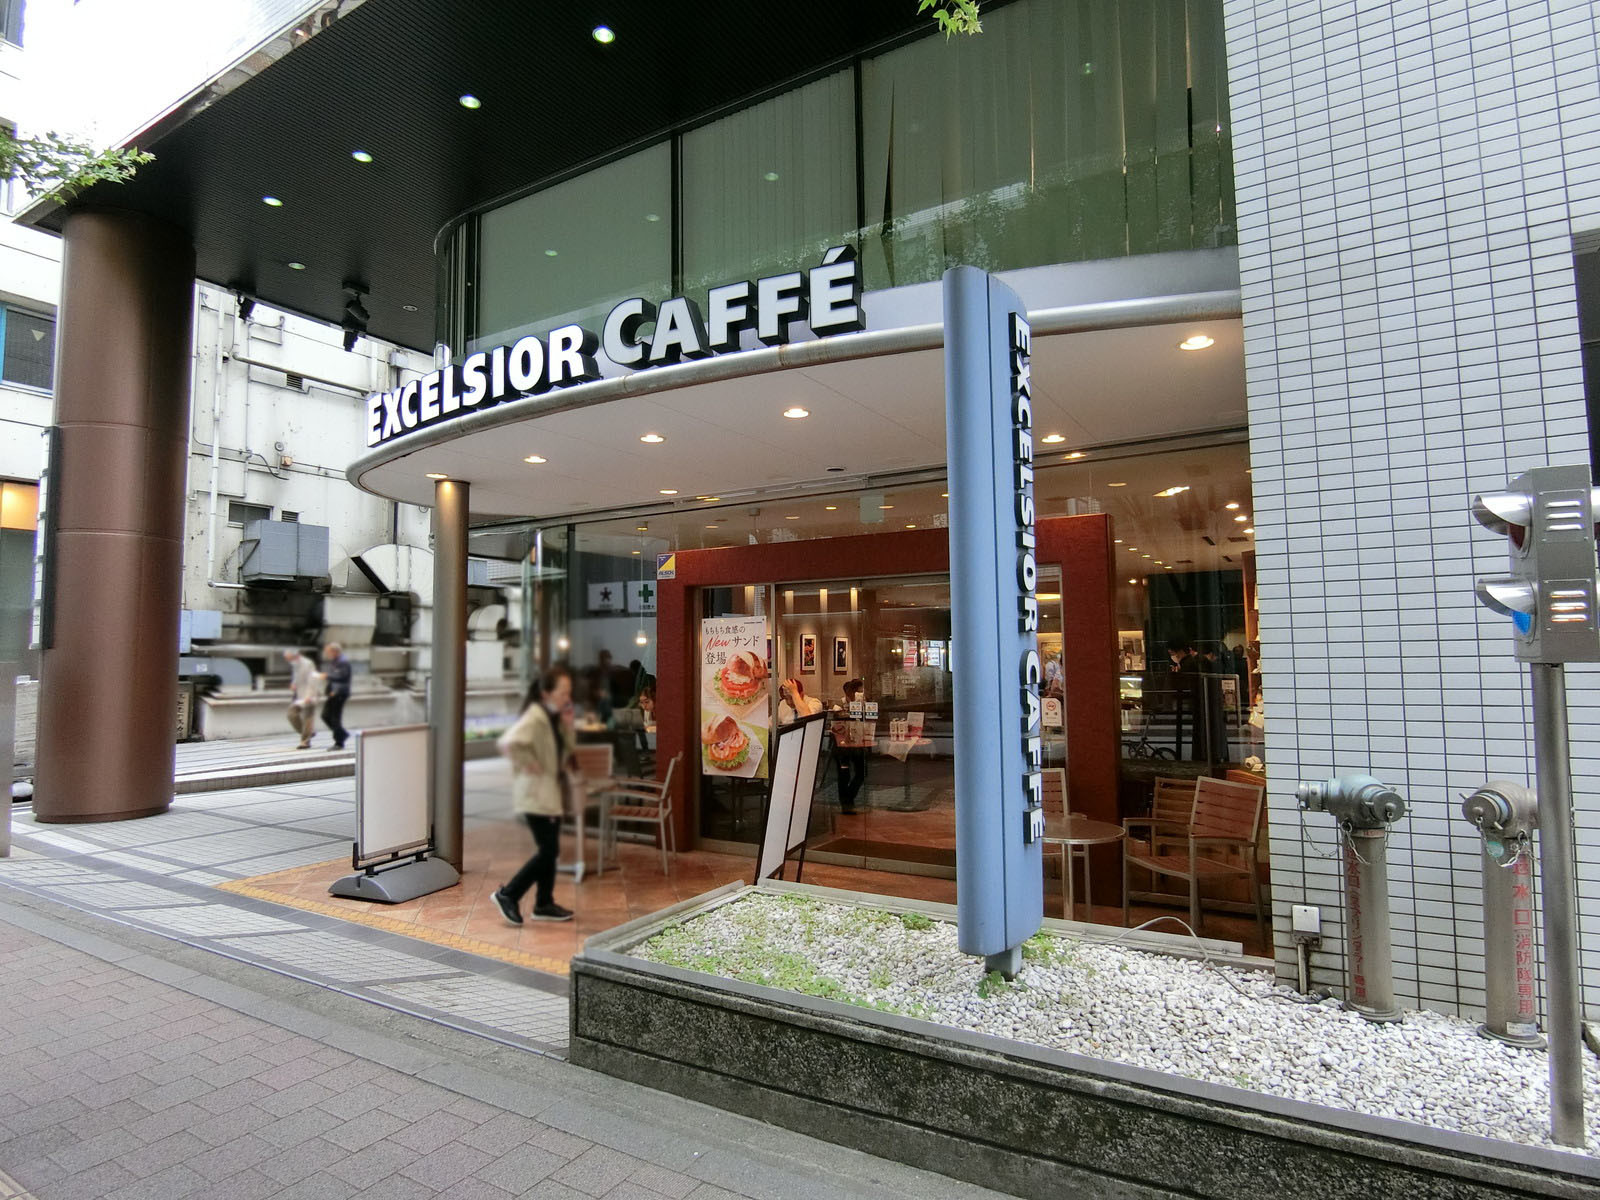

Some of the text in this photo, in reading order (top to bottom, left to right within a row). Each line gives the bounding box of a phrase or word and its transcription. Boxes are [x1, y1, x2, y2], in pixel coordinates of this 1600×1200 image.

[367, 244, 862, 447] EXCELSIOR CAFFÉ
[1008, 312, 1037, 633] EXCELSIOR
[705, 635, 760, 652] New サンド
[705, 651, 727, 665] 登場
